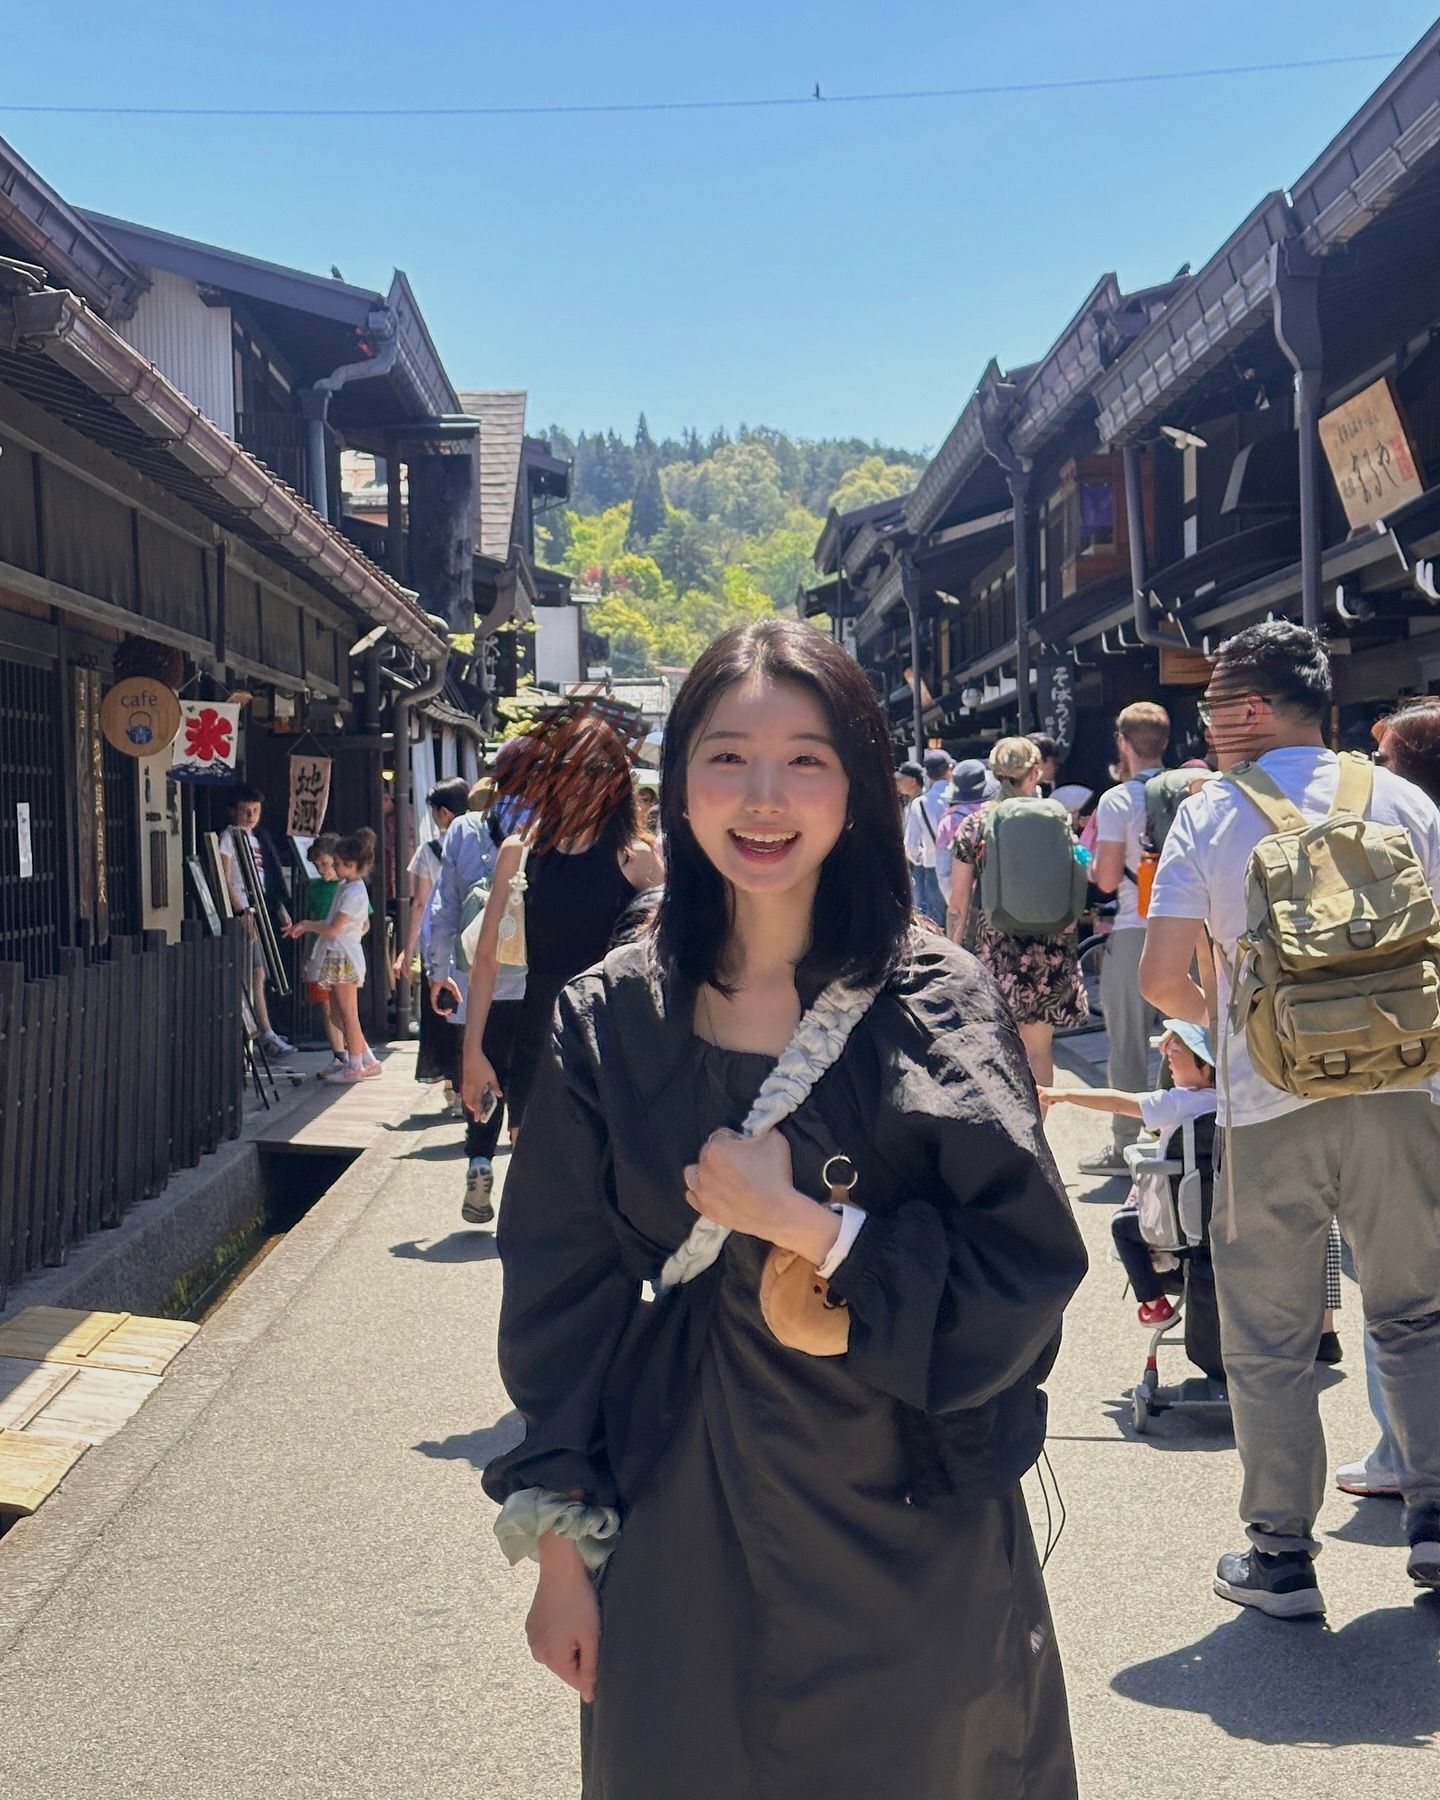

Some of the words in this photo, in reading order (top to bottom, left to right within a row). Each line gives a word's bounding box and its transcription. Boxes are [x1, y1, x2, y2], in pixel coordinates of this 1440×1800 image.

[184, 708, 233, 762] 氷
[1051, 666, 1073, 747] そばうどん
[292, 764, 324, 833] 地酒
